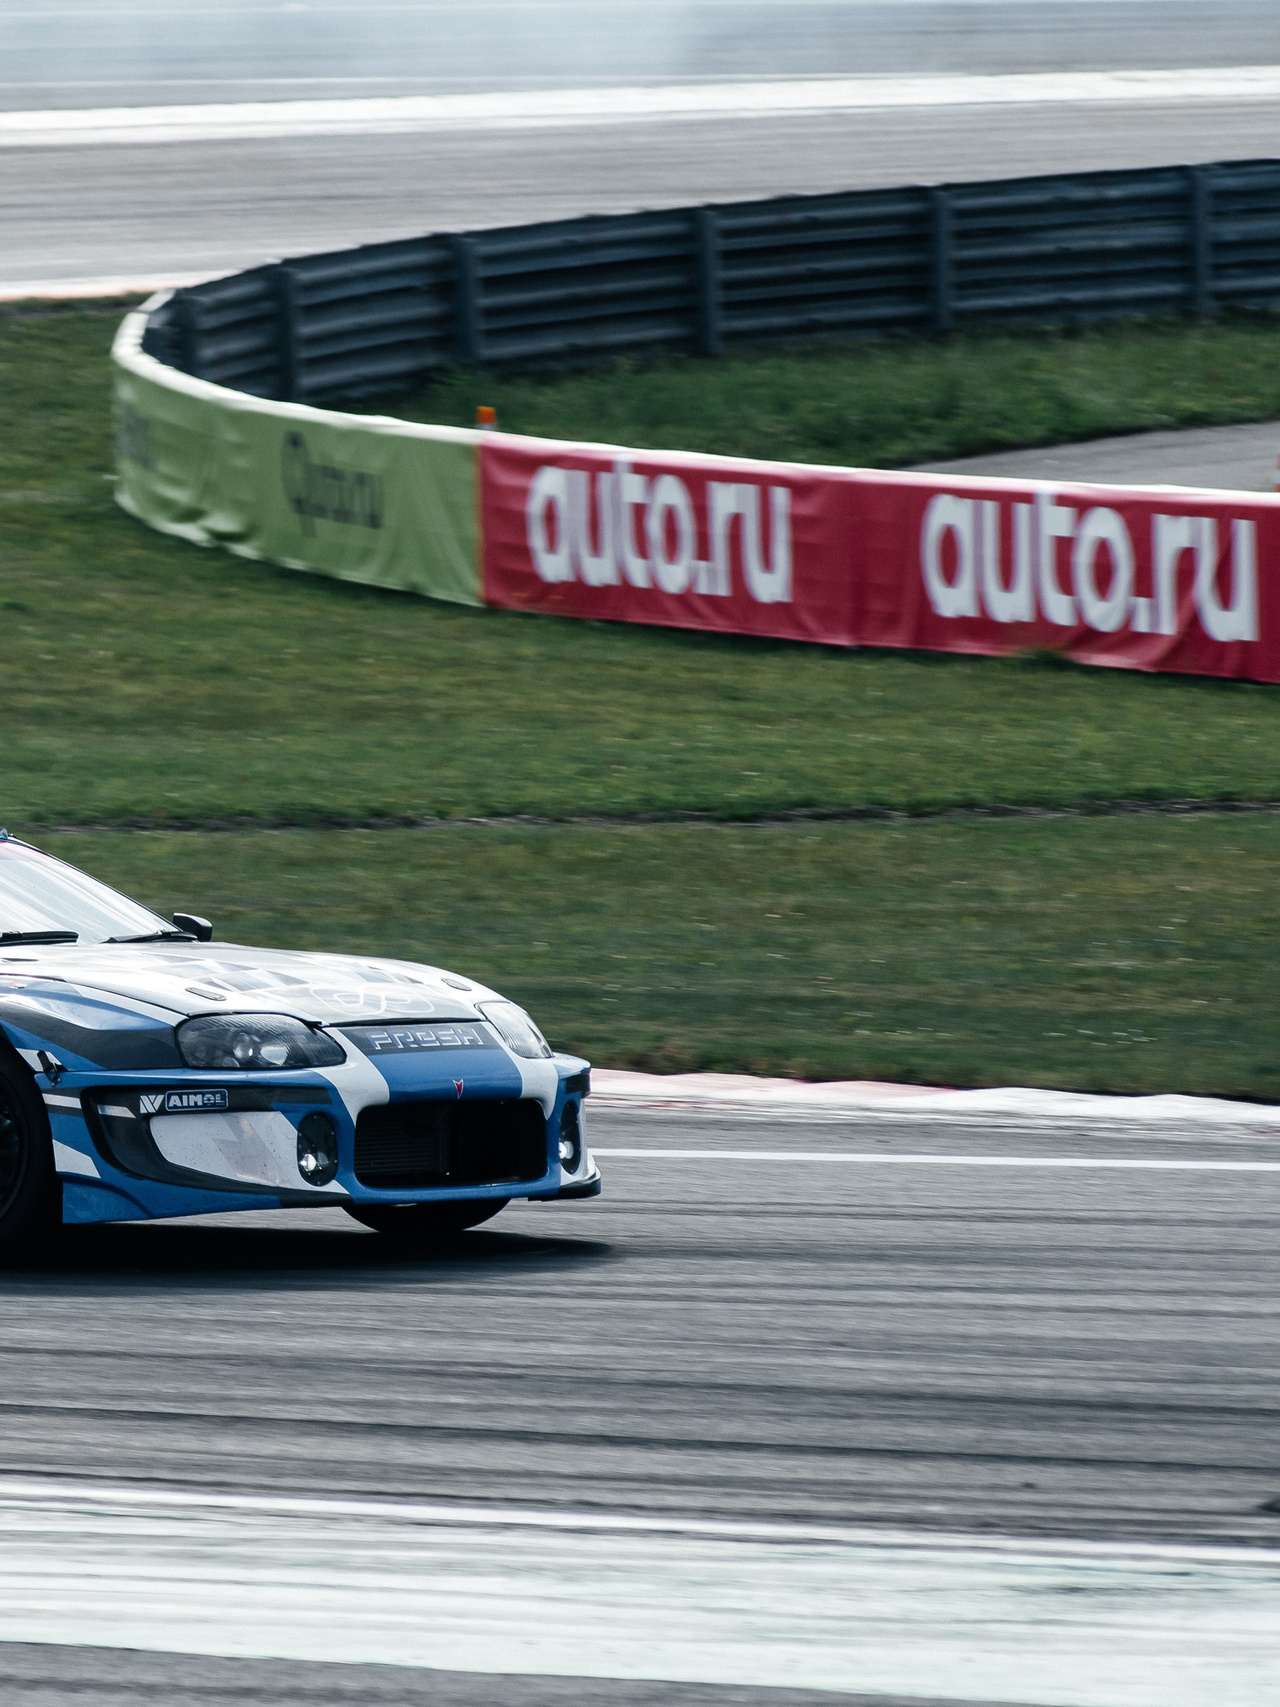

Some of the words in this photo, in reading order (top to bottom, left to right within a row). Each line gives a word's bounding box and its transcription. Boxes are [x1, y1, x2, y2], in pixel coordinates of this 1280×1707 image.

[527, 454, 792, 603] auto.ru
[923, 488, 1256, 642] auto.ru
[167, 1094, 225, 1108] AIMOL
